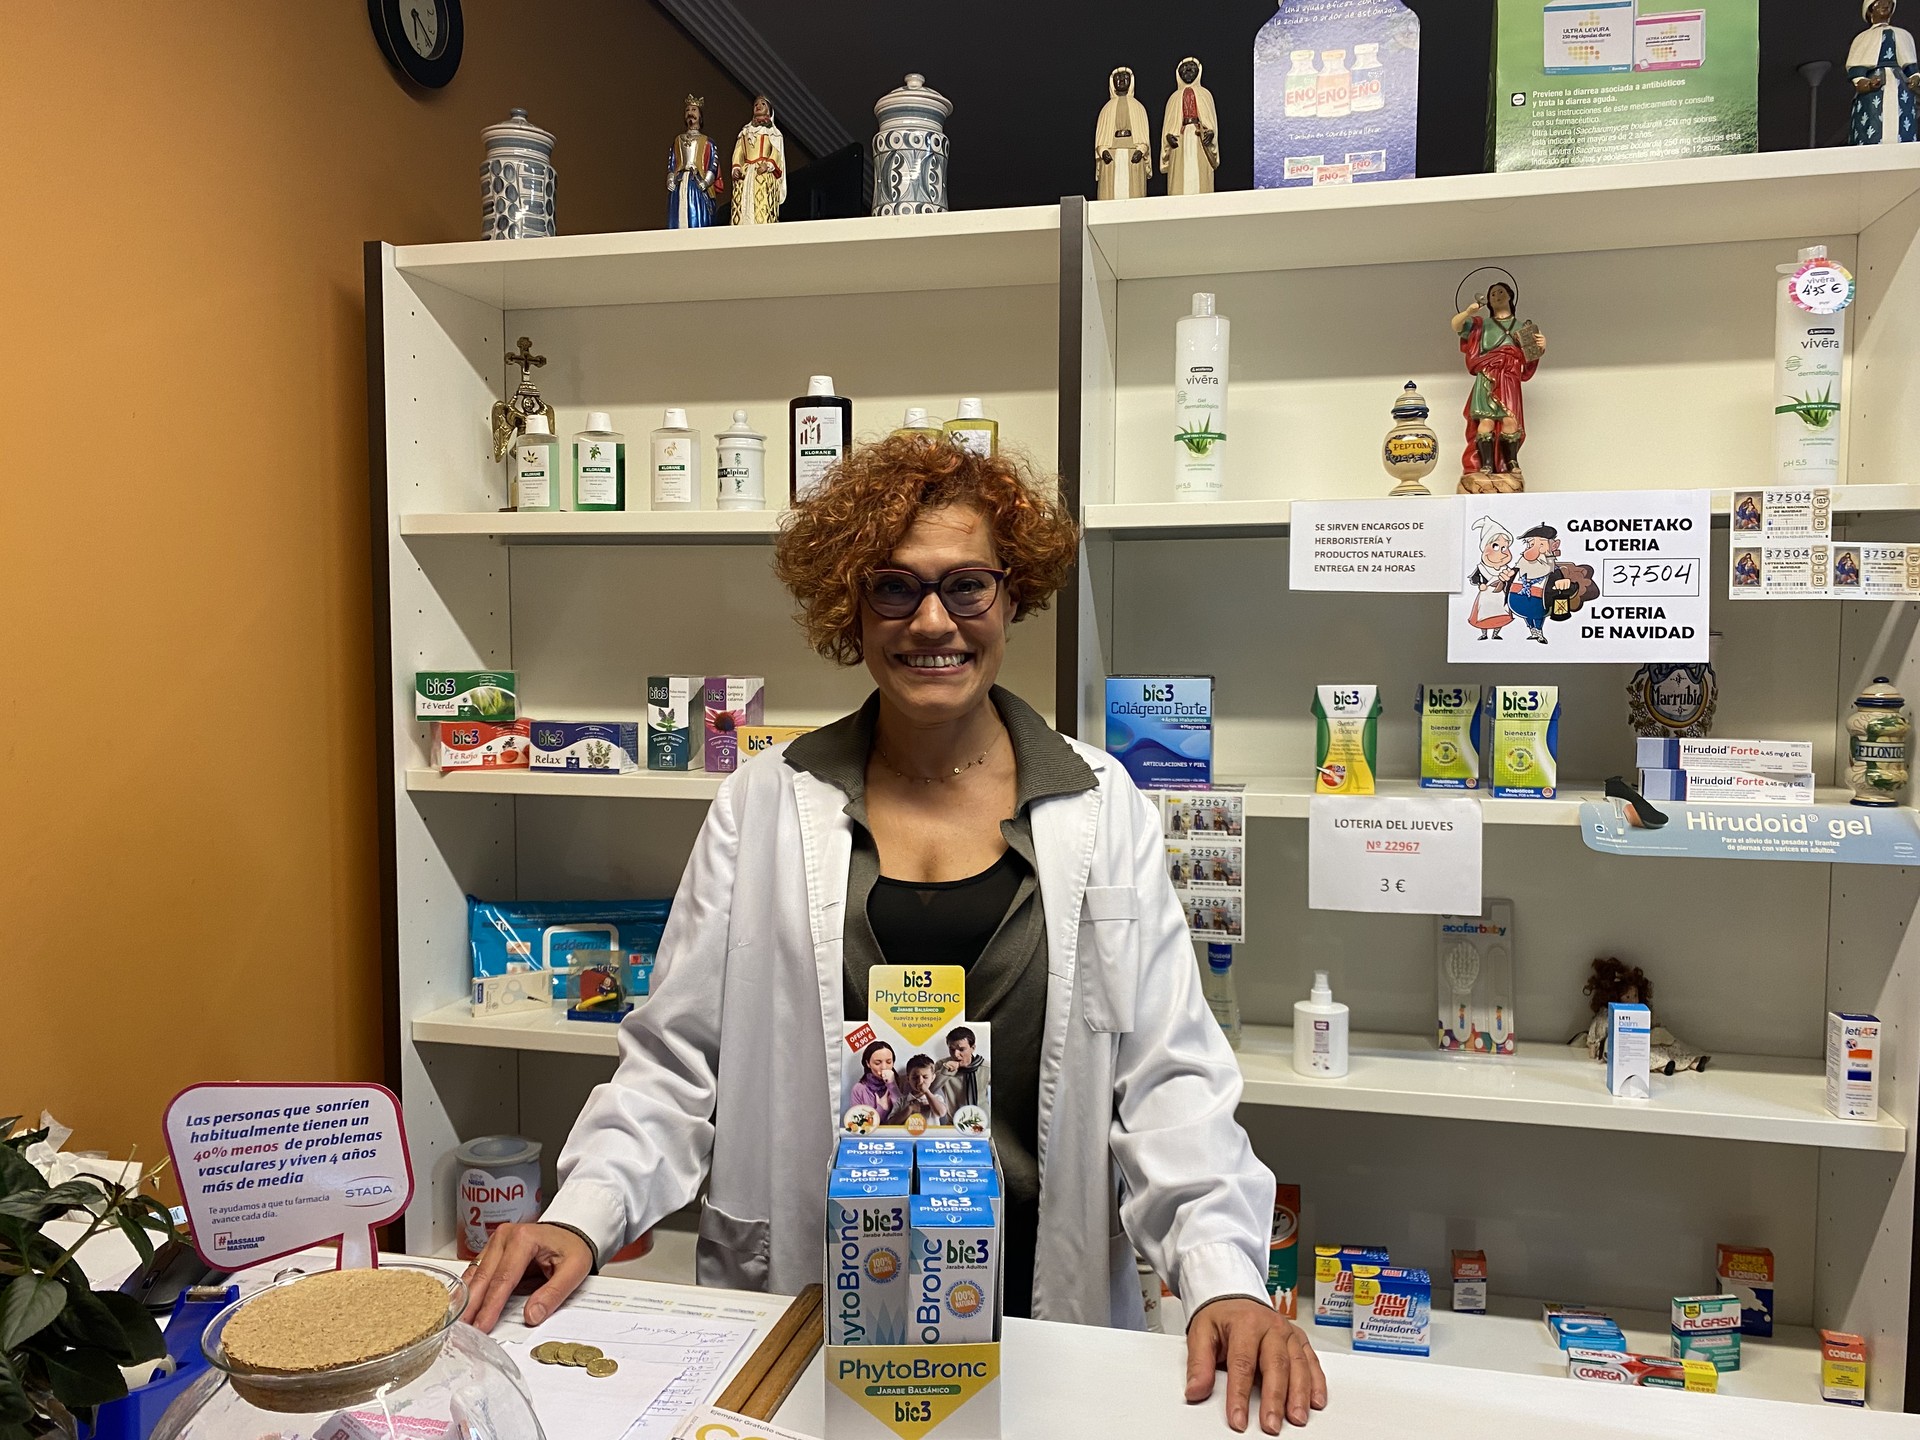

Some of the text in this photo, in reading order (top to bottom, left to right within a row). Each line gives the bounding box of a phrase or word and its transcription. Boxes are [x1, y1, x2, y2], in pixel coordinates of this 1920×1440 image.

[1287, 81, 1380, 106] ENO ENO ENO
[1532, 90, 1563, 98] Previene
[1600, 84, 1634, 94] asociada
[1642, 79, 1686, 90] antibióticos
[1291, 160, 1371, 182] ENO ENO ENO
[1831, 283, 1842, 293] €
[1767, 494, 1811, 502] 37504
[1412, 522, 1424, 530] DE
[1567, 518, 1693, 532] GABONETAKO
[1314, 535, 1384, 544] HERBORISTERÍA
[1585, 538, 1660, 551] LOTERIA
[1371, 550, 1426, 558] NATURALES.
[1765, 550, 1905, 559] 37504 37504
[1612, 563, 1692, 587] 37504
[1591, 606, 1666, 619] LOTERIA
[1581, 626, 1695, 639] DE NAVIDAD
[427, 679, 456, 695] bio3
[649, 686, 669, 700] bio3
[1651, 685, 1704, 706] Marrubio
[433, 702, 454, 710] Verde
[1111, 702, 1207, 719] Colágeno Forte
[461, 753, 478, 762] Rojo
[1730, 746, 1760, 756] Forte
[535, 754, 561, 764] Relax
[1191, 799, 1227, 807] 22967
[1334, 818, 1454, 831] LOTERIA DEL JUEVES
[1828, 815, 1873, 840] gel
[1366, 840, 1420, 851] Nº 22967
[1781, 839, 1808, 847] pesadez
[1190, 848, 1226, 857] 22967
[1380, 878, 1406, 892] 3 €
[1442, 923, 1507, 936] acofarbaby
[875, 990, 960, 1005] PhytoBronc
[849, 1026, 871, 1043] OFERTA
[854, 1036, 868, 1049] 9,90
[186, 1098, 369, 1127] Las personas que sonríen
[190, 1116, 369, 1143] habitualmente tienen un
[193, 1131, 383, 1163] 40% menos de problemas
[198, 1147, 377, 1177] vasculares y viven 4 años
[202, 1171, 304, 1194] más de media
[345, 1185, 393, 1199] STADA
[461, 1184, 524, 1203] NIDINA
[208, 1207, 217, 1215] Te
[218, 1203, 260, 1215] ayudamos
[267, 1200, 284, 1209] que
[294, 1194, 330, 1205] farmacia
[211, 1210, 278, 1225] avance cada día.
[469, 1206, 482, 1227] 2
[863, 1207, 903, 1232] bio3
[226, 1243, 259, 1251] MASVIDA
[946, 1239, 989, 1264] bio3
[1728, 1271, 1768, 1281] LIQUIDO
[955, 1290, 975, 1301] 100%
[1375, 1294, 1408, 1309] fitty
[955, 1300, 976, 1308] NATURAL
[1373, 1307, 1405, 1318] dent
[1369, 1316, 1413, 1325] Comprimidos
[1684, 1317, 1739, 1328] ALGASIV
[1360, 1322, 1421, 1335] Limpiadores
[1828, 1349, 1863, 1361] COREGA
[840, 1358, 987, 1383] PhytoBronc
[1579, 1367, 1622, 1382] COREGA
[710, 1409, 774, 1433] Ejemplar Gratuito
